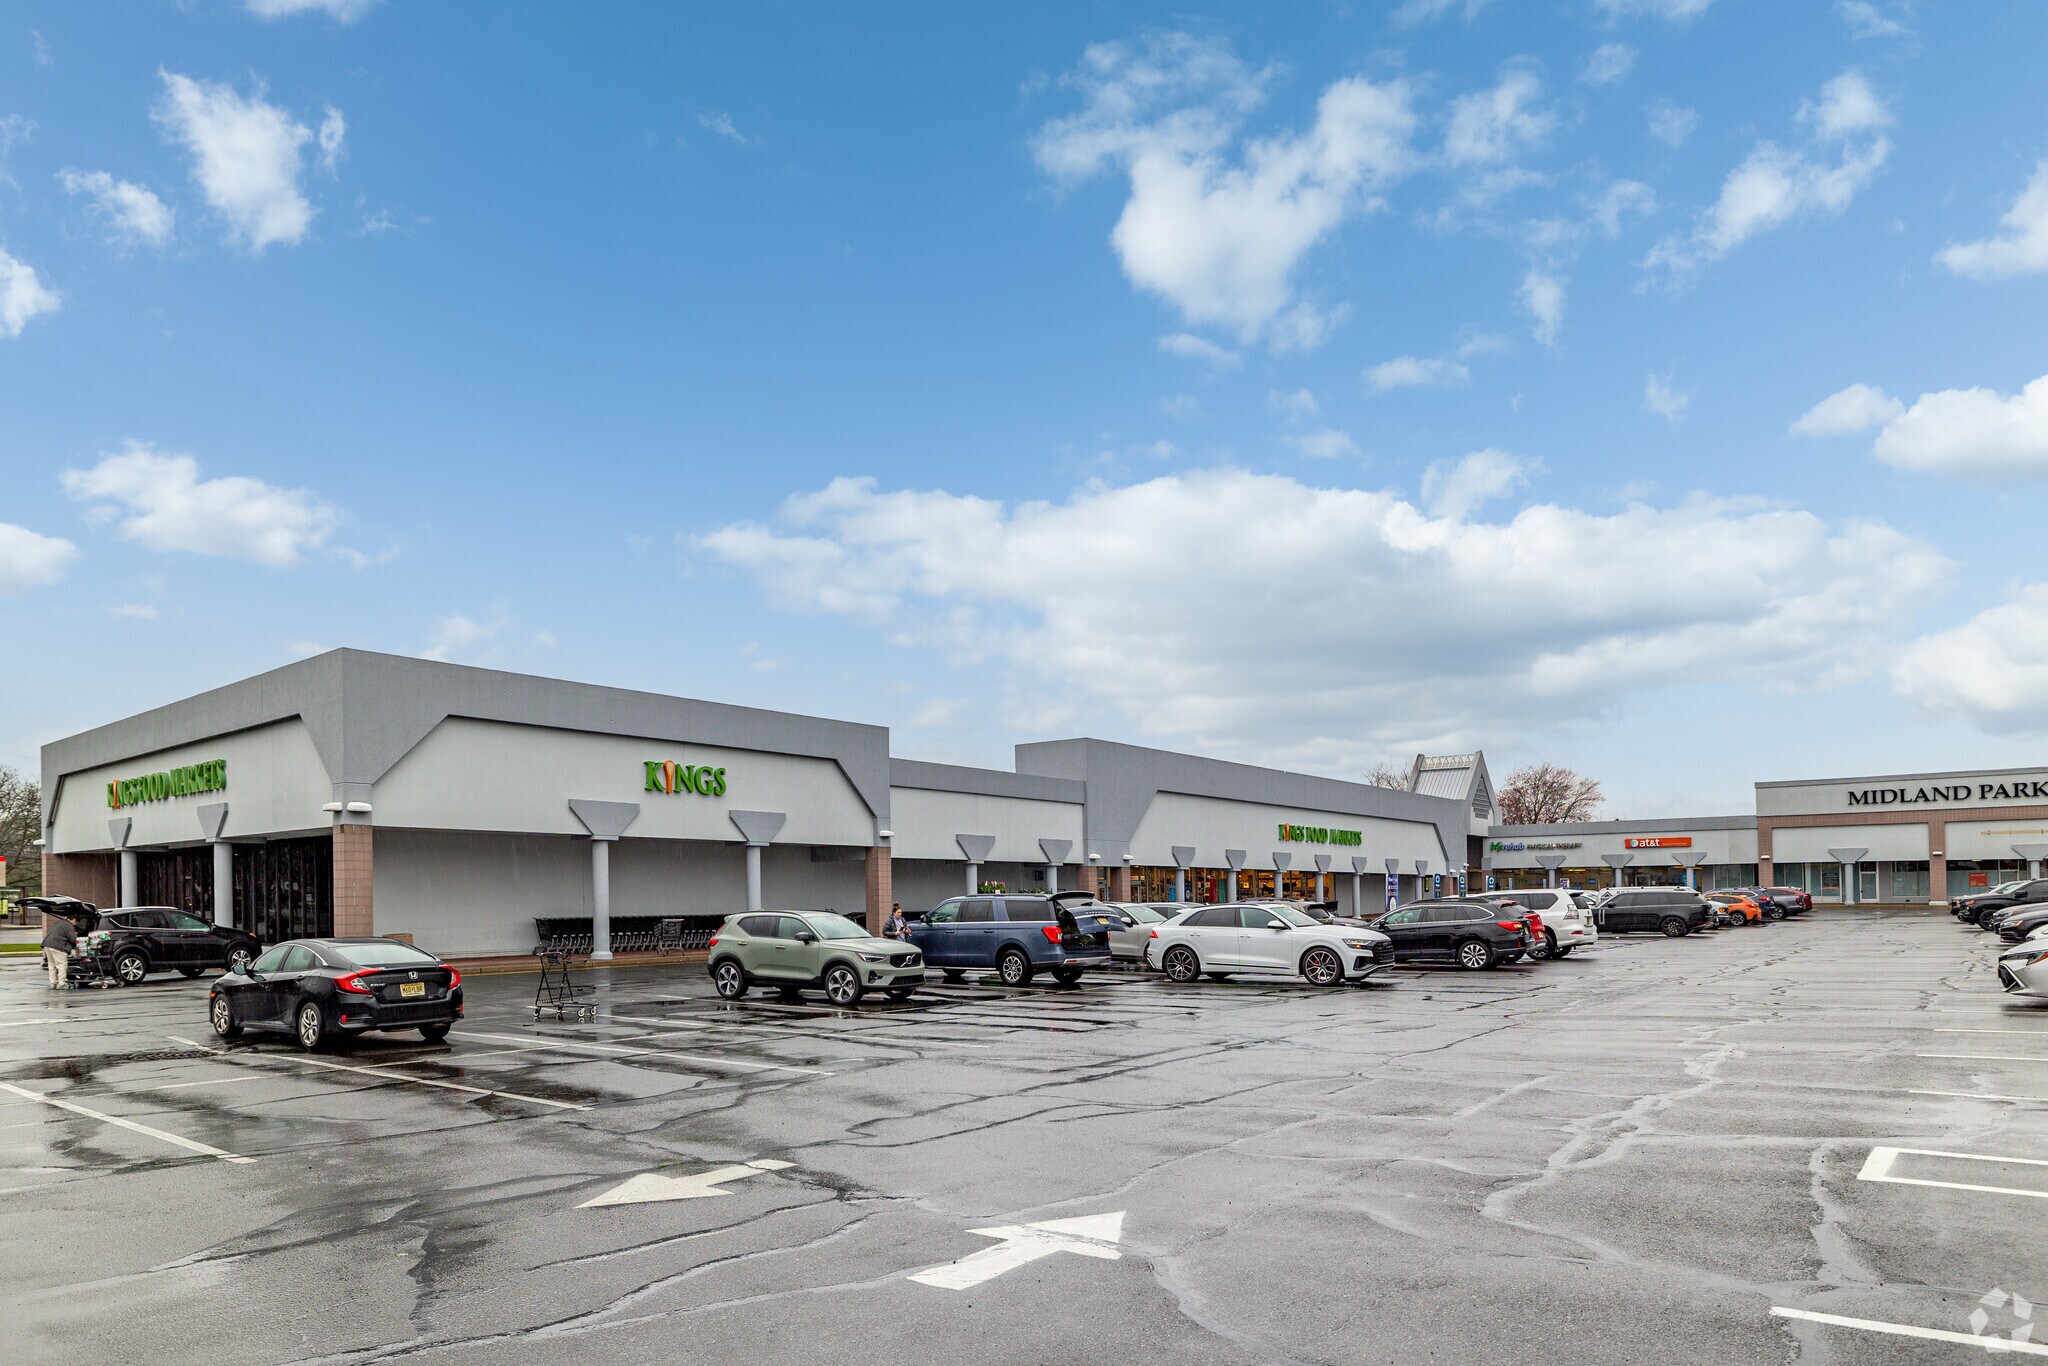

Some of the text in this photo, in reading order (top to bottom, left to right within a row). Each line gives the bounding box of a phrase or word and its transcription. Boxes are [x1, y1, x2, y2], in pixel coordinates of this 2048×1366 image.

[169, 759, 227, 797] MARKETS
[644, 760, 727, 796] KINGS
[1848, 781, 2048, 805] MIDLAND PARK
[1278, 822, 1362, 847] KINGS FOOD MARKETS
[1639, 838, 1660, 847] at&t
